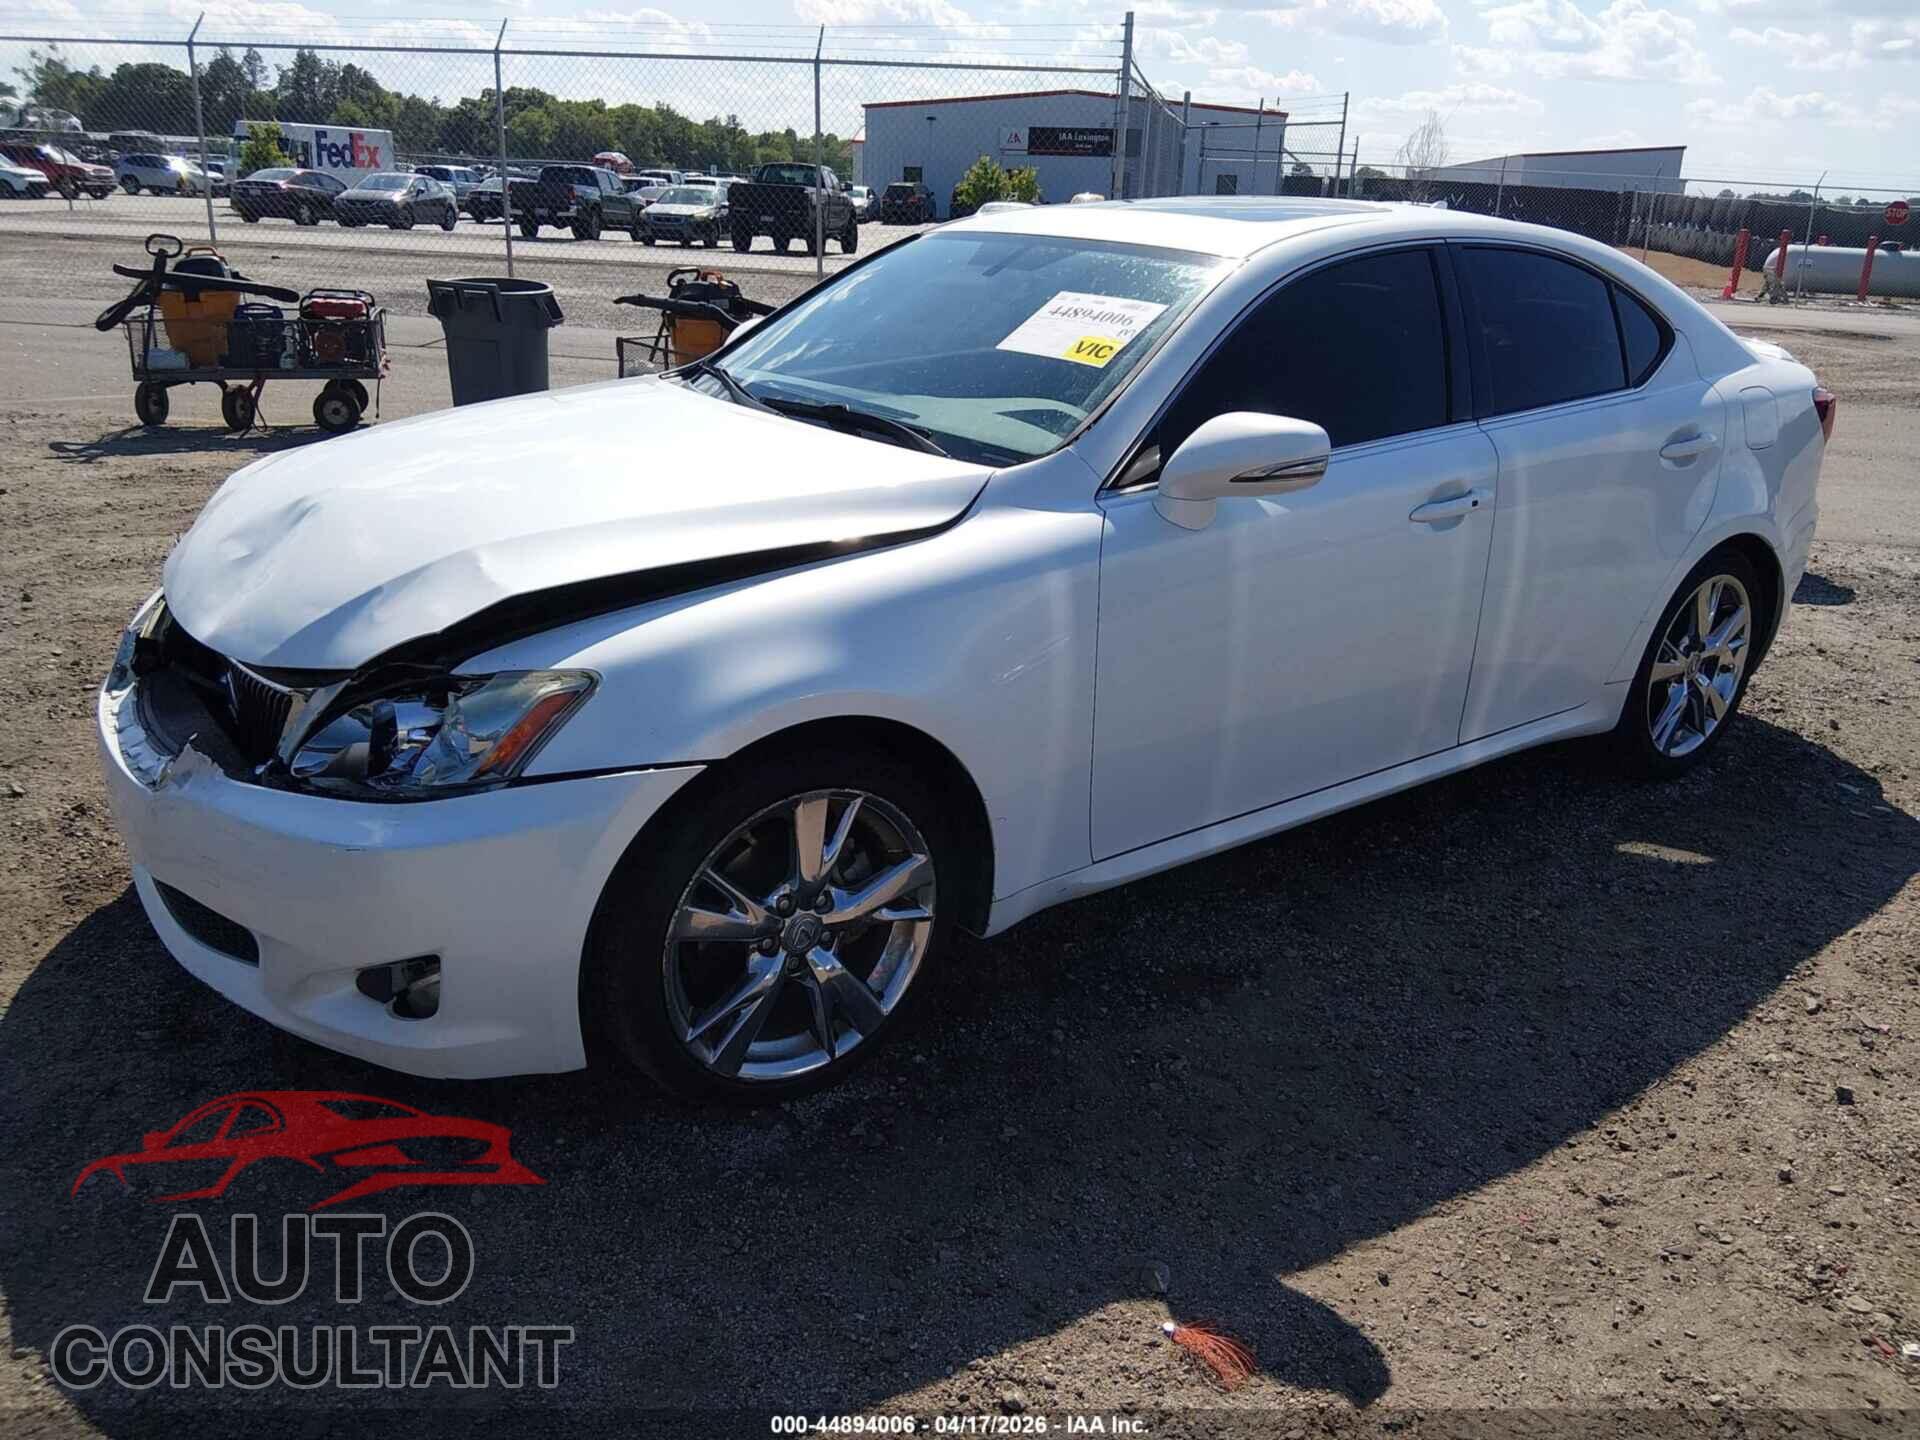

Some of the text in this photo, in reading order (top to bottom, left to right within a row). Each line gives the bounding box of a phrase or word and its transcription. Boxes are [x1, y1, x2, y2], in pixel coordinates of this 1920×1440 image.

[314, 130, 381, 169] FedEx
[1887, 207, 1908, 218] STOP
[1048, 304, 1134, 327] 44894006
[1074, 340, 1114, 359] VIC
